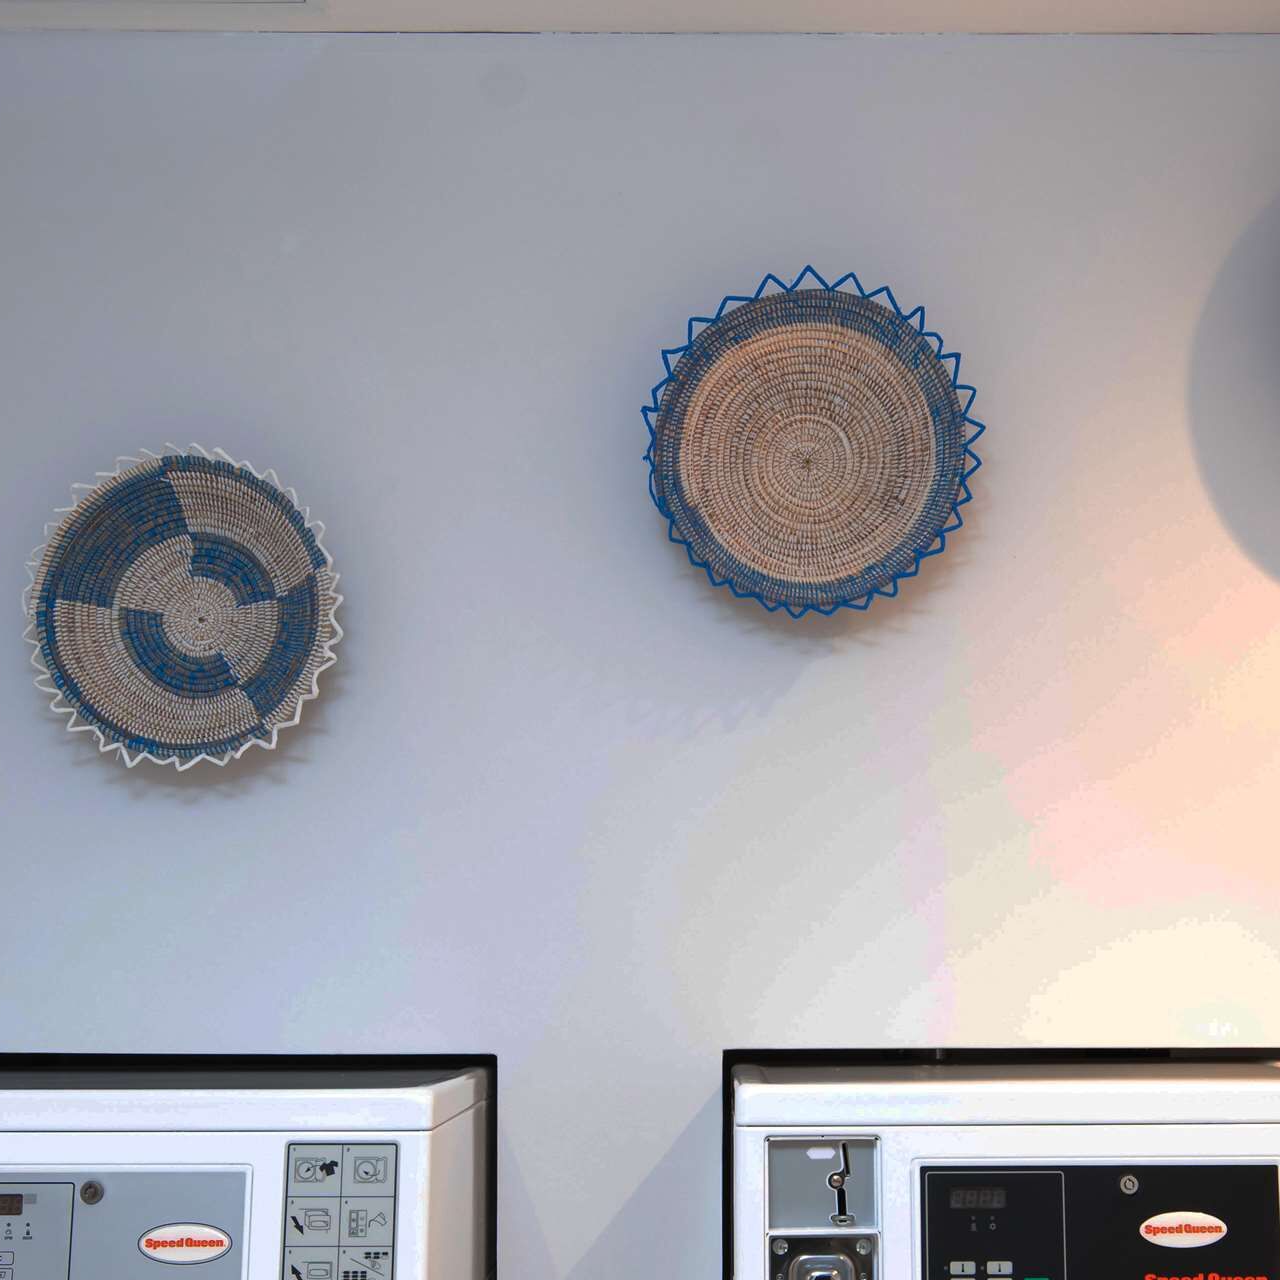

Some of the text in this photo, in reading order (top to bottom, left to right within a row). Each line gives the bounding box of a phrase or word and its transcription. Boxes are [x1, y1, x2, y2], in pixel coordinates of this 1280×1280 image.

[1145, 1224, 1223, 1236] Speed Queen
[145, 1238, 224, 1250] Speed Queen
